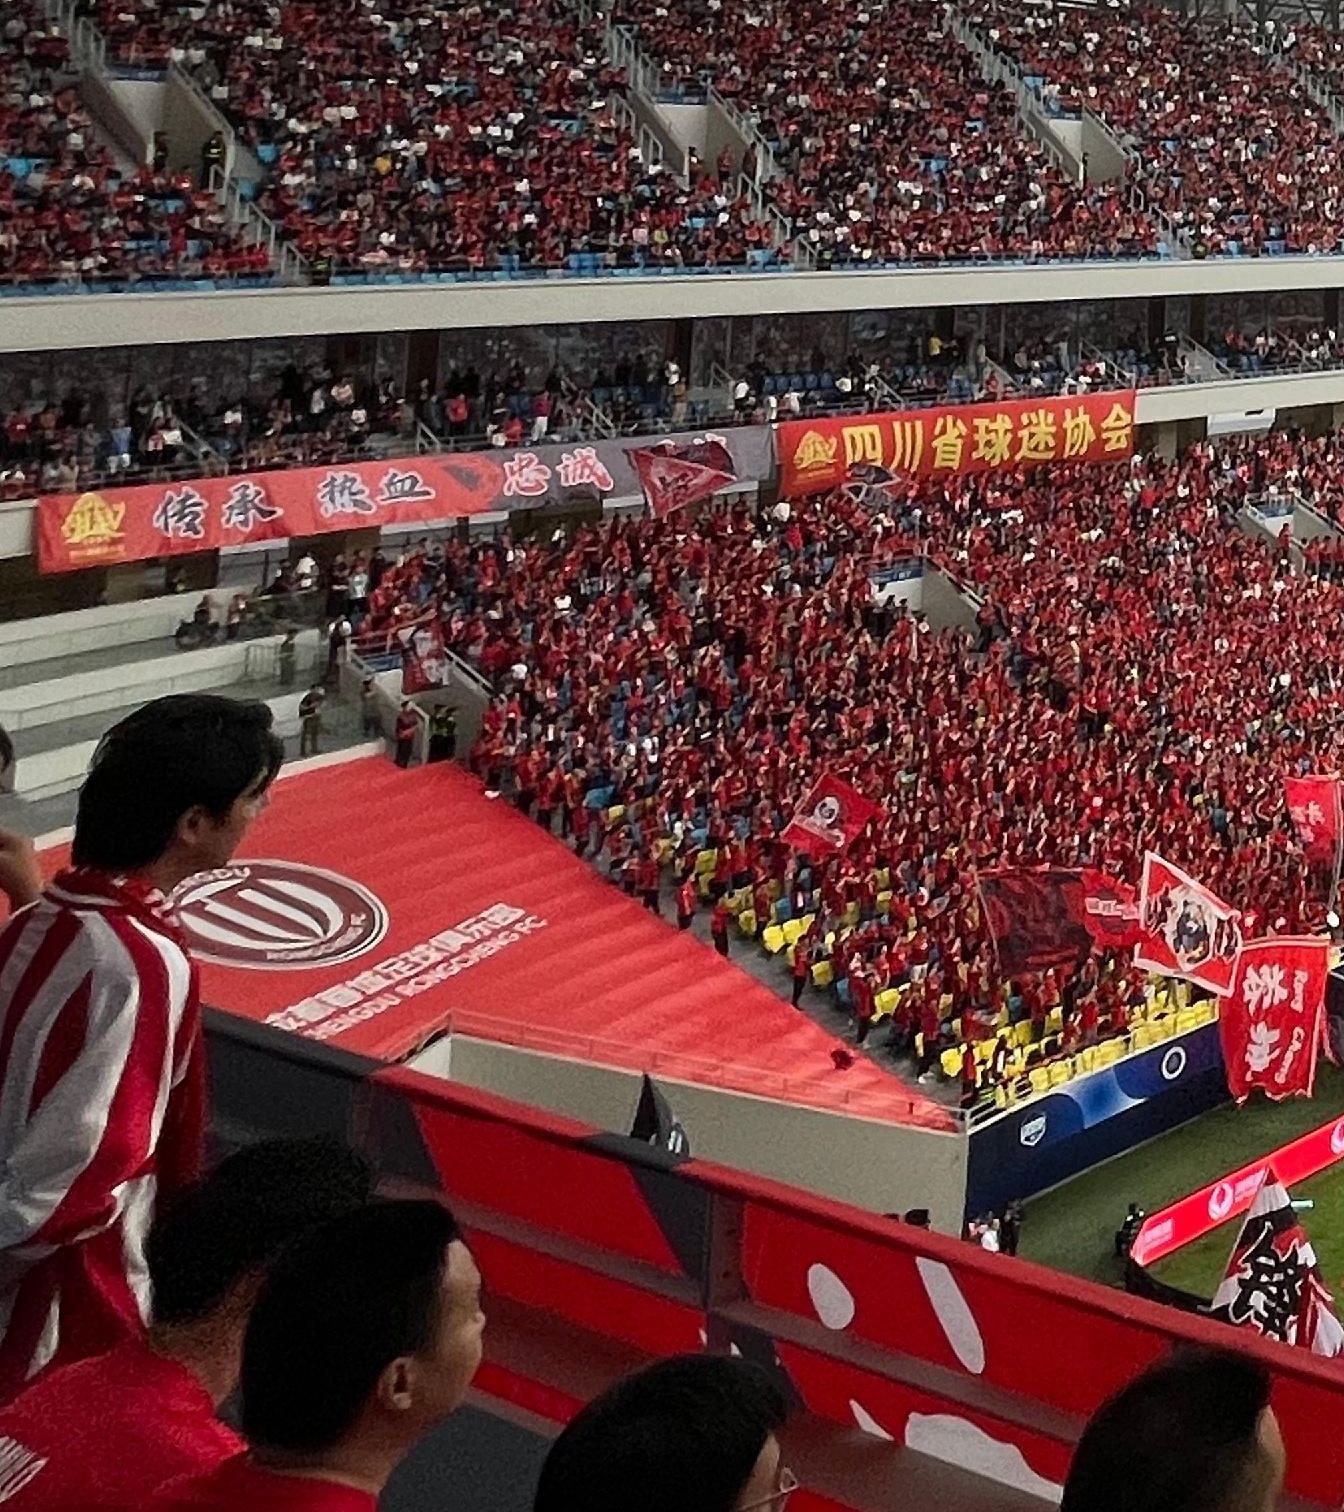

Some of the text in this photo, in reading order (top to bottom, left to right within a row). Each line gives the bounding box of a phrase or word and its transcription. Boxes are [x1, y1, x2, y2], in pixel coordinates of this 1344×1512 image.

[841, 402, 1132, 473] 四川省球迷协会
[152, 446, 614, 538] 传承 热血 忠诚
